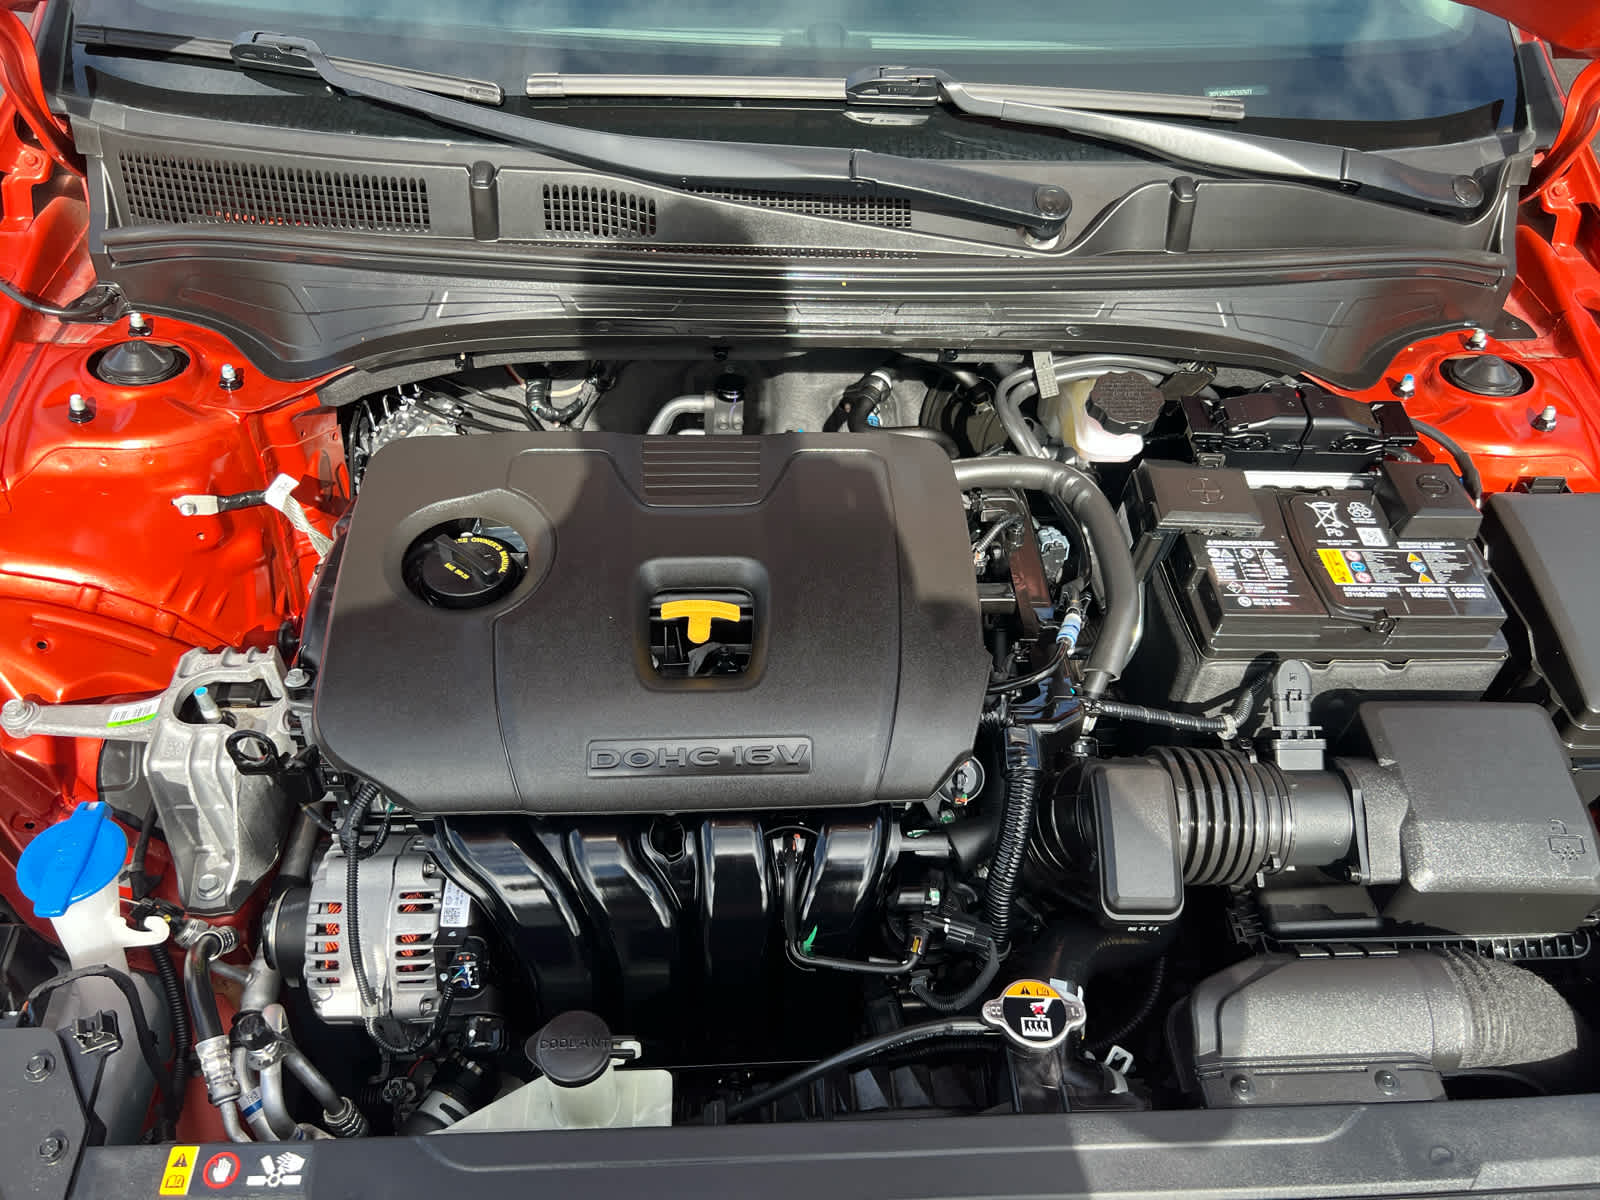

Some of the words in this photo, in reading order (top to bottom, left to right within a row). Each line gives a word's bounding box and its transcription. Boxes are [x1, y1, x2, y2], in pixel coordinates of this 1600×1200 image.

[1326, 527, 1344, 537] Pb
[590, 746, 720, 770] DOHC
[732, 744, 808, 767] 16V
[540, 1038, 610, 1050] COOLANT
